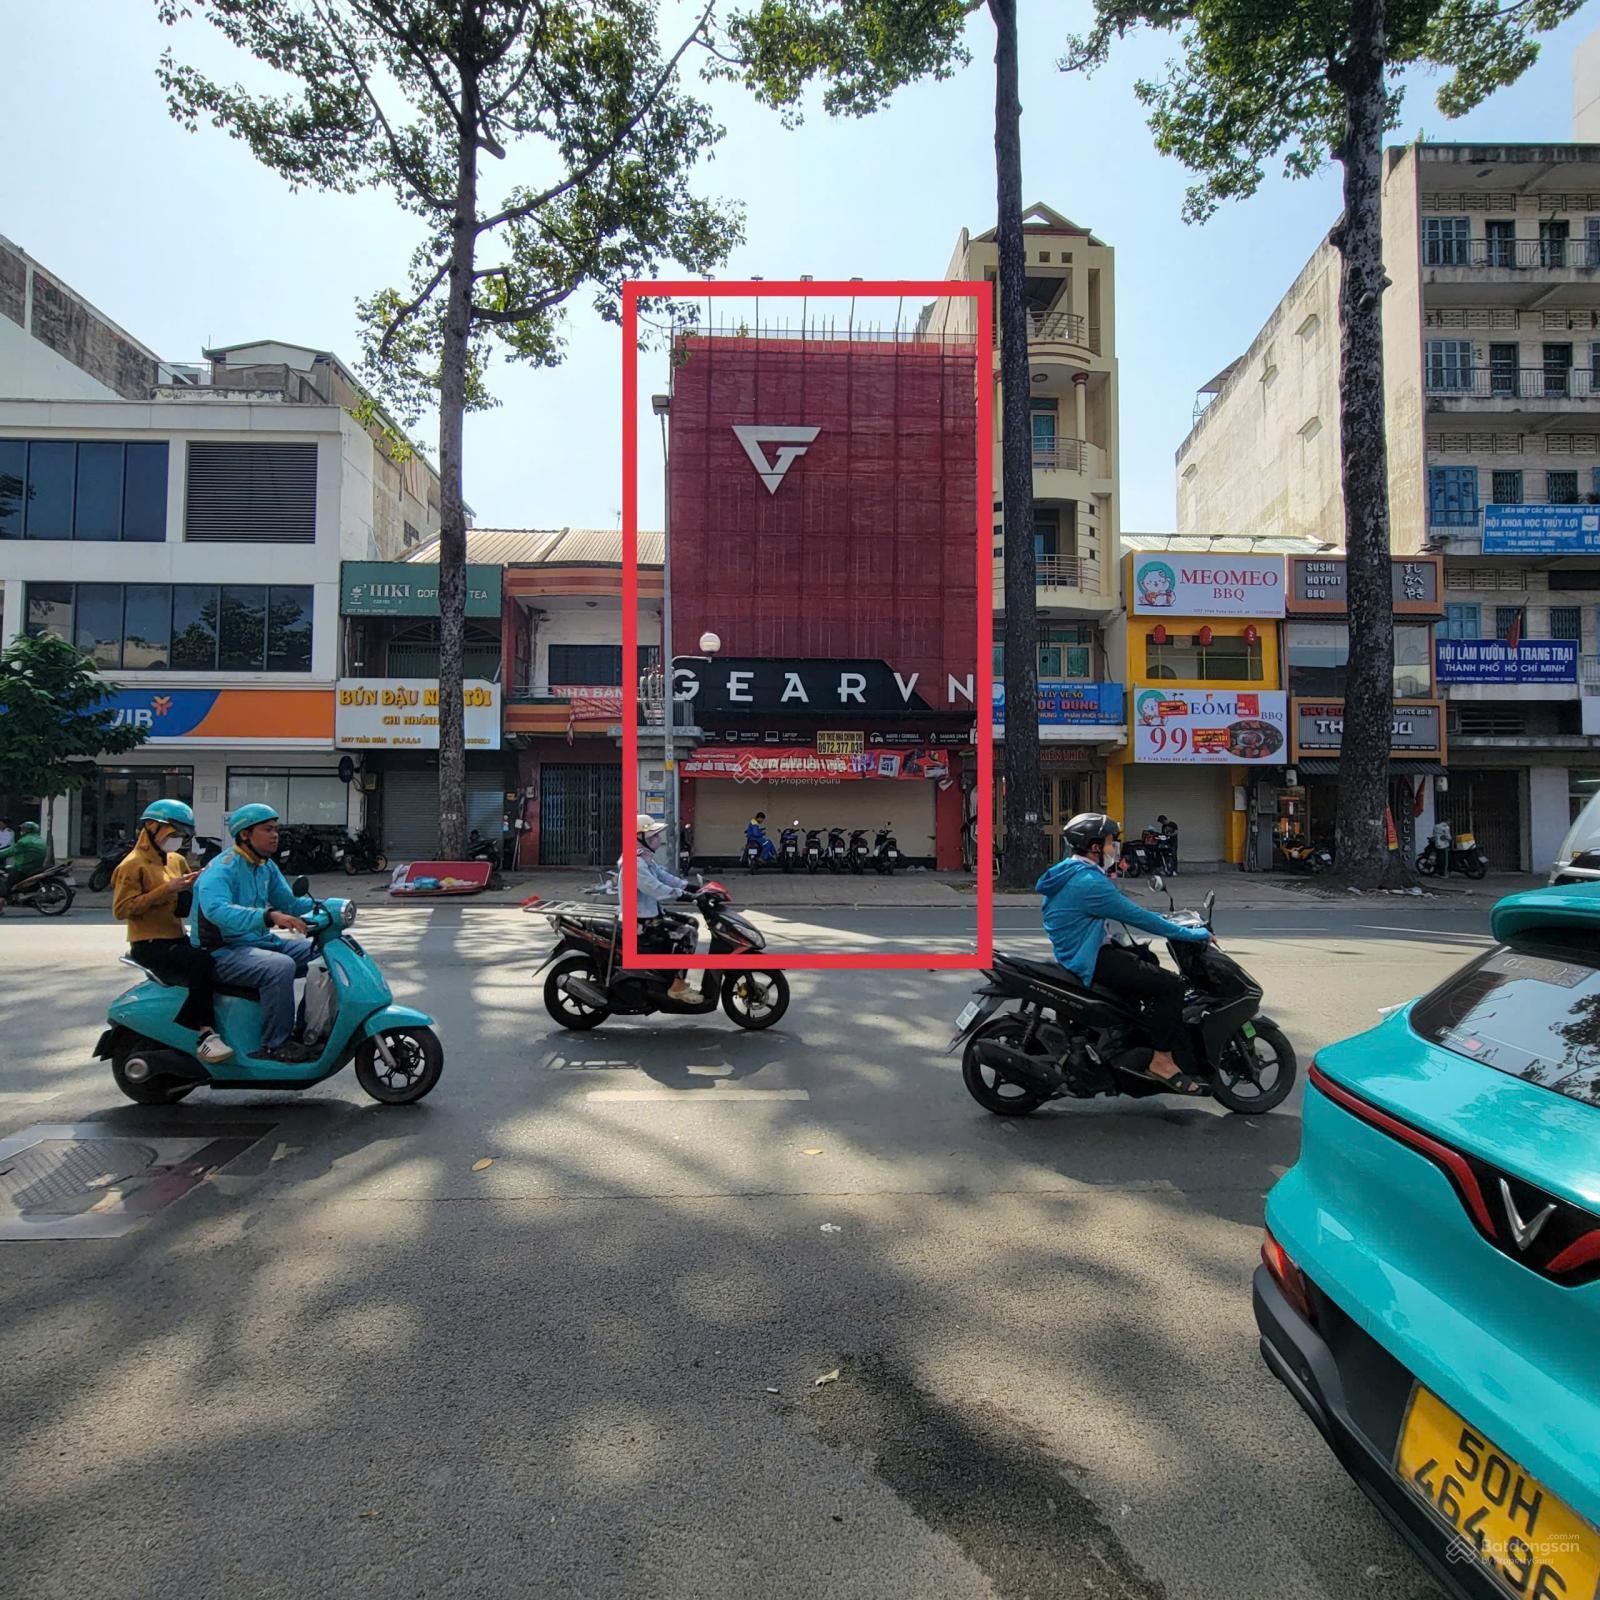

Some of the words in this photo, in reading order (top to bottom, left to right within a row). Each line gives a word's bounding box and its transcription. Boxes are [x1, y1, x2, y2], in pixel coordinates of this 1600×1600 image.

[1501, 518, 1522, 528] KHOA
[1306, 563, 1335, 572] SUSHI
[1404, 563, 1422, 574] すし
[1180, 569, 1278, 586] MEOMEO
[1306, 576, 1341, 585] HOTPOT
[469, 590, 488, 599] TEA
[1213, 588, 1245, 602] BBQ
[1306, 589, 1326, 599] BBQ
[1439, 644, 1455, 662] HỘI
[1457, 644, 1477, 660] LÀM
[1480, 643, 1506, 660] VƯỜN
[1520, 647, 1550, 661] TRANG
[1552, 647, 1573, 664] TRẠI
[1445, 661, 1476, 672] THÀNH
[1480, 660, 1500, 672] PHỐ
[1540, 664, 1566, 672] MINH
[672, 669, 974, 703] GEARVN
[340, 686, 377, 706] BÚN
[382, 686, 419, 709] ĐẬU
[464, 687, 492, 706] TÔI
[1260, 711, 1283, 721] BBQ
[1455, 1428, 1543, 1537] 50H
